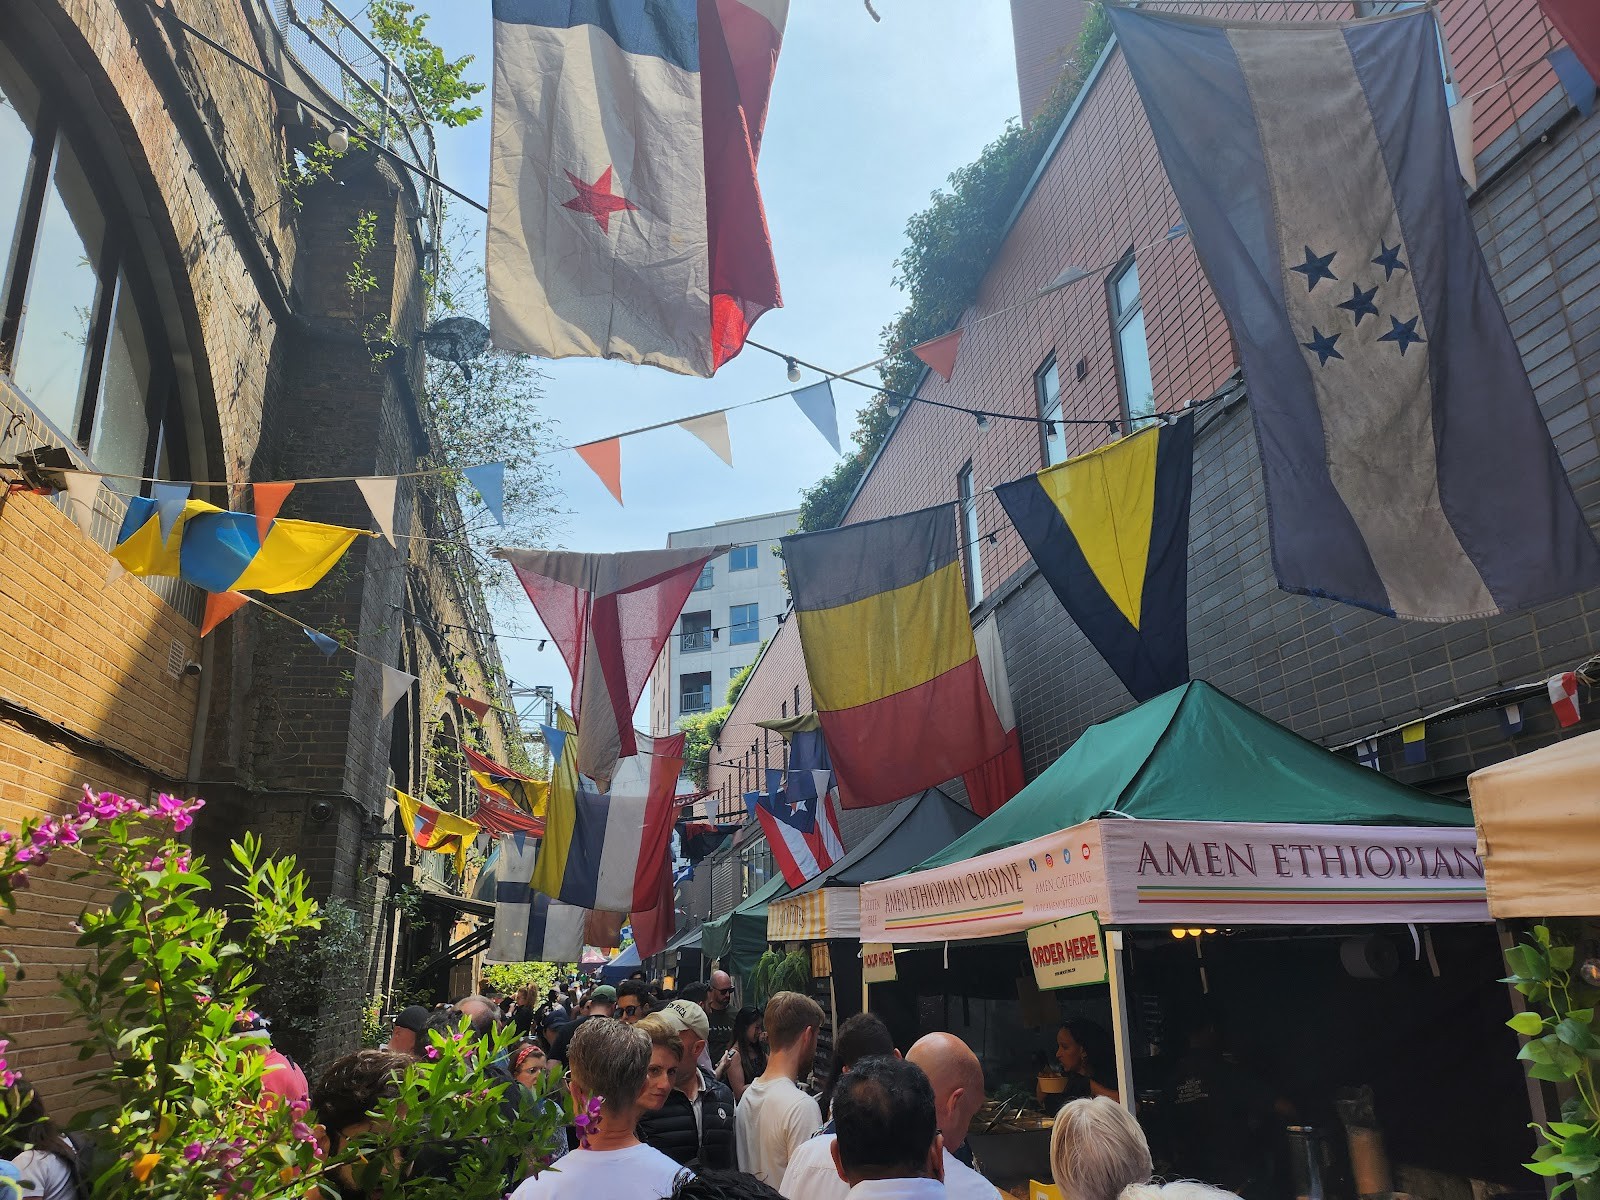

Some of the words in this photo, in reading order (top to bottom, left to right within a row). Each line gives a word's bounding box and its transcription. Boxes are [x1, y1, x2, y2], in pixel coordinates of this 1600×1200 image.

[1137, 840, 1258, 878] AMEN
[1268, 843, 1485, 880] ETHIOPIAN
[885, 889, 910, 914] AMEN
[909, 876, 966, 911] ETHIOPIAN
[965, 862, 1024, 900] CUISINE
[878, 951, 894, 967] HERE
[1031, 941, 1066, 969] ORDER
[1064, 934, 1099, 962] HERE
